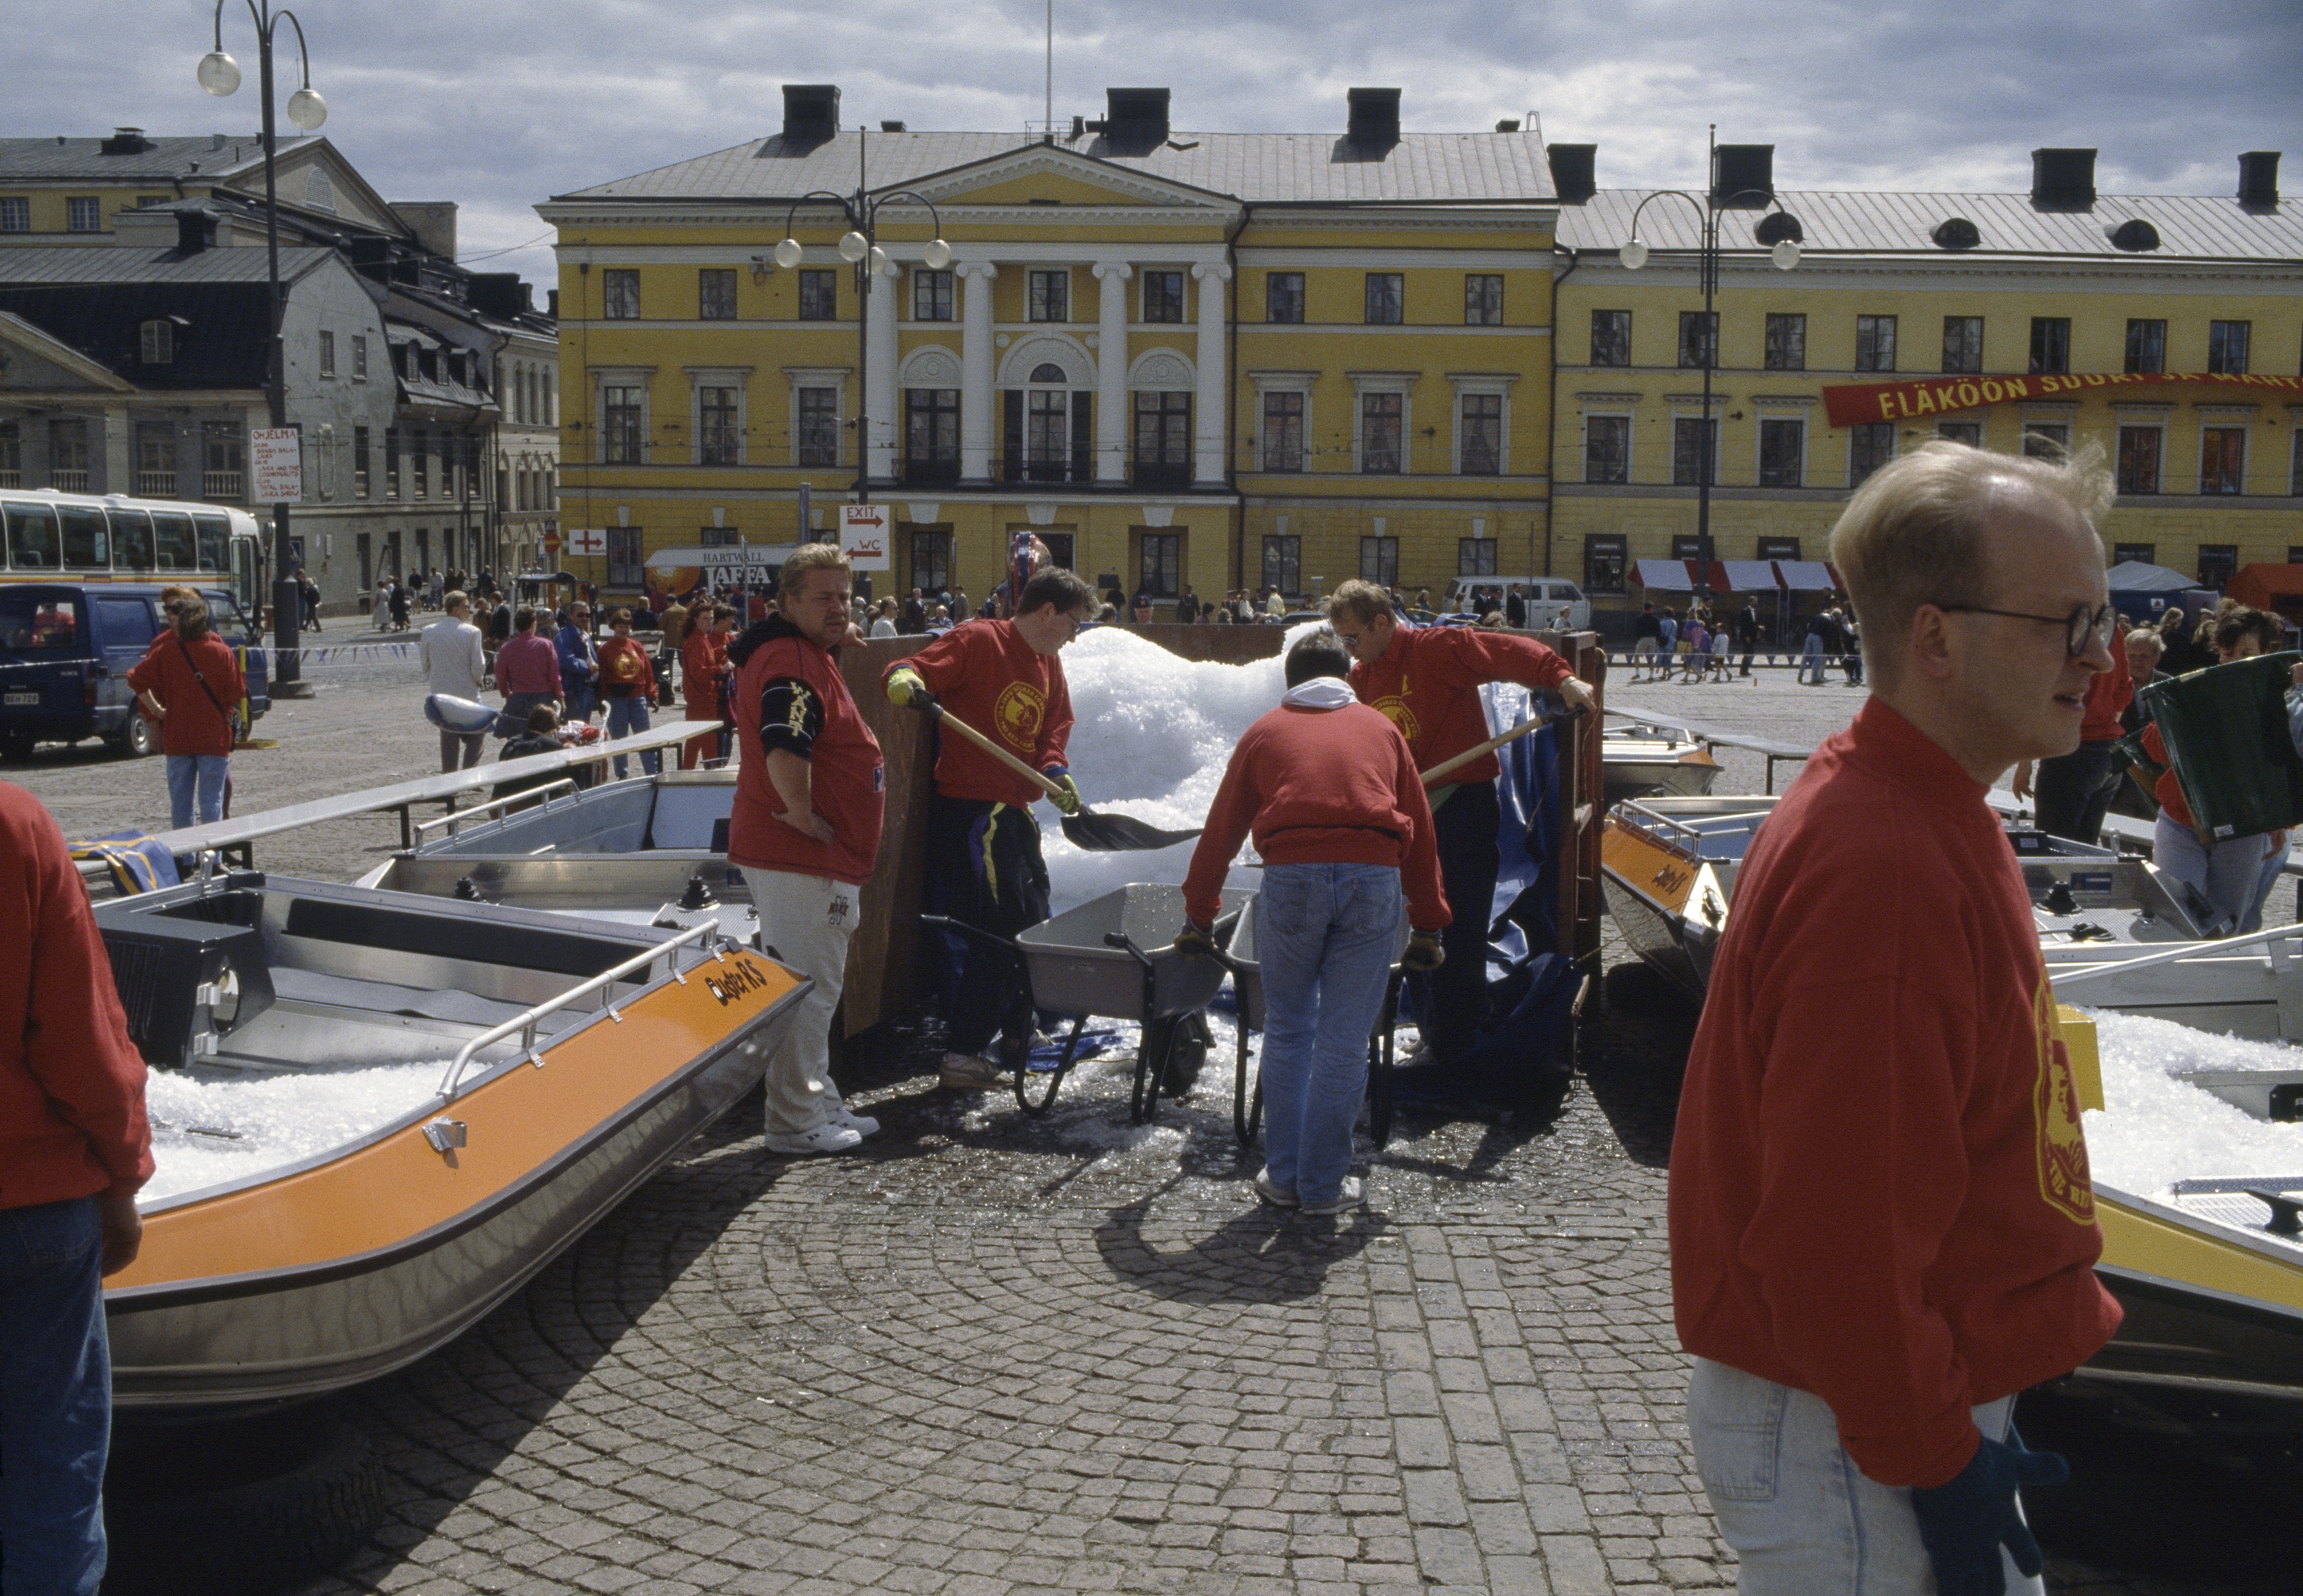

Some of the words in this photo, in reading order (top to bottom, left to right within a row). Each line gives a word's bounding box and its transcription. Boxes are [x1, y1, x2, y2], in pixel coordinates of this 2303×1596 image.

[1878, 376, 2028, 420] ELÄKÖÖN
[2211, 373, 2303, 389] MAHT
[253, 429, 297, 440] OHJELMA
[847, 506, 876, 518] EXIT
[859, 540, 880, 550] WC
[703, 552, 764, 562] HARTWALL
[705, 566, 772, 595] JAFFA
[2049, 1157, 2067, 1196] THE
